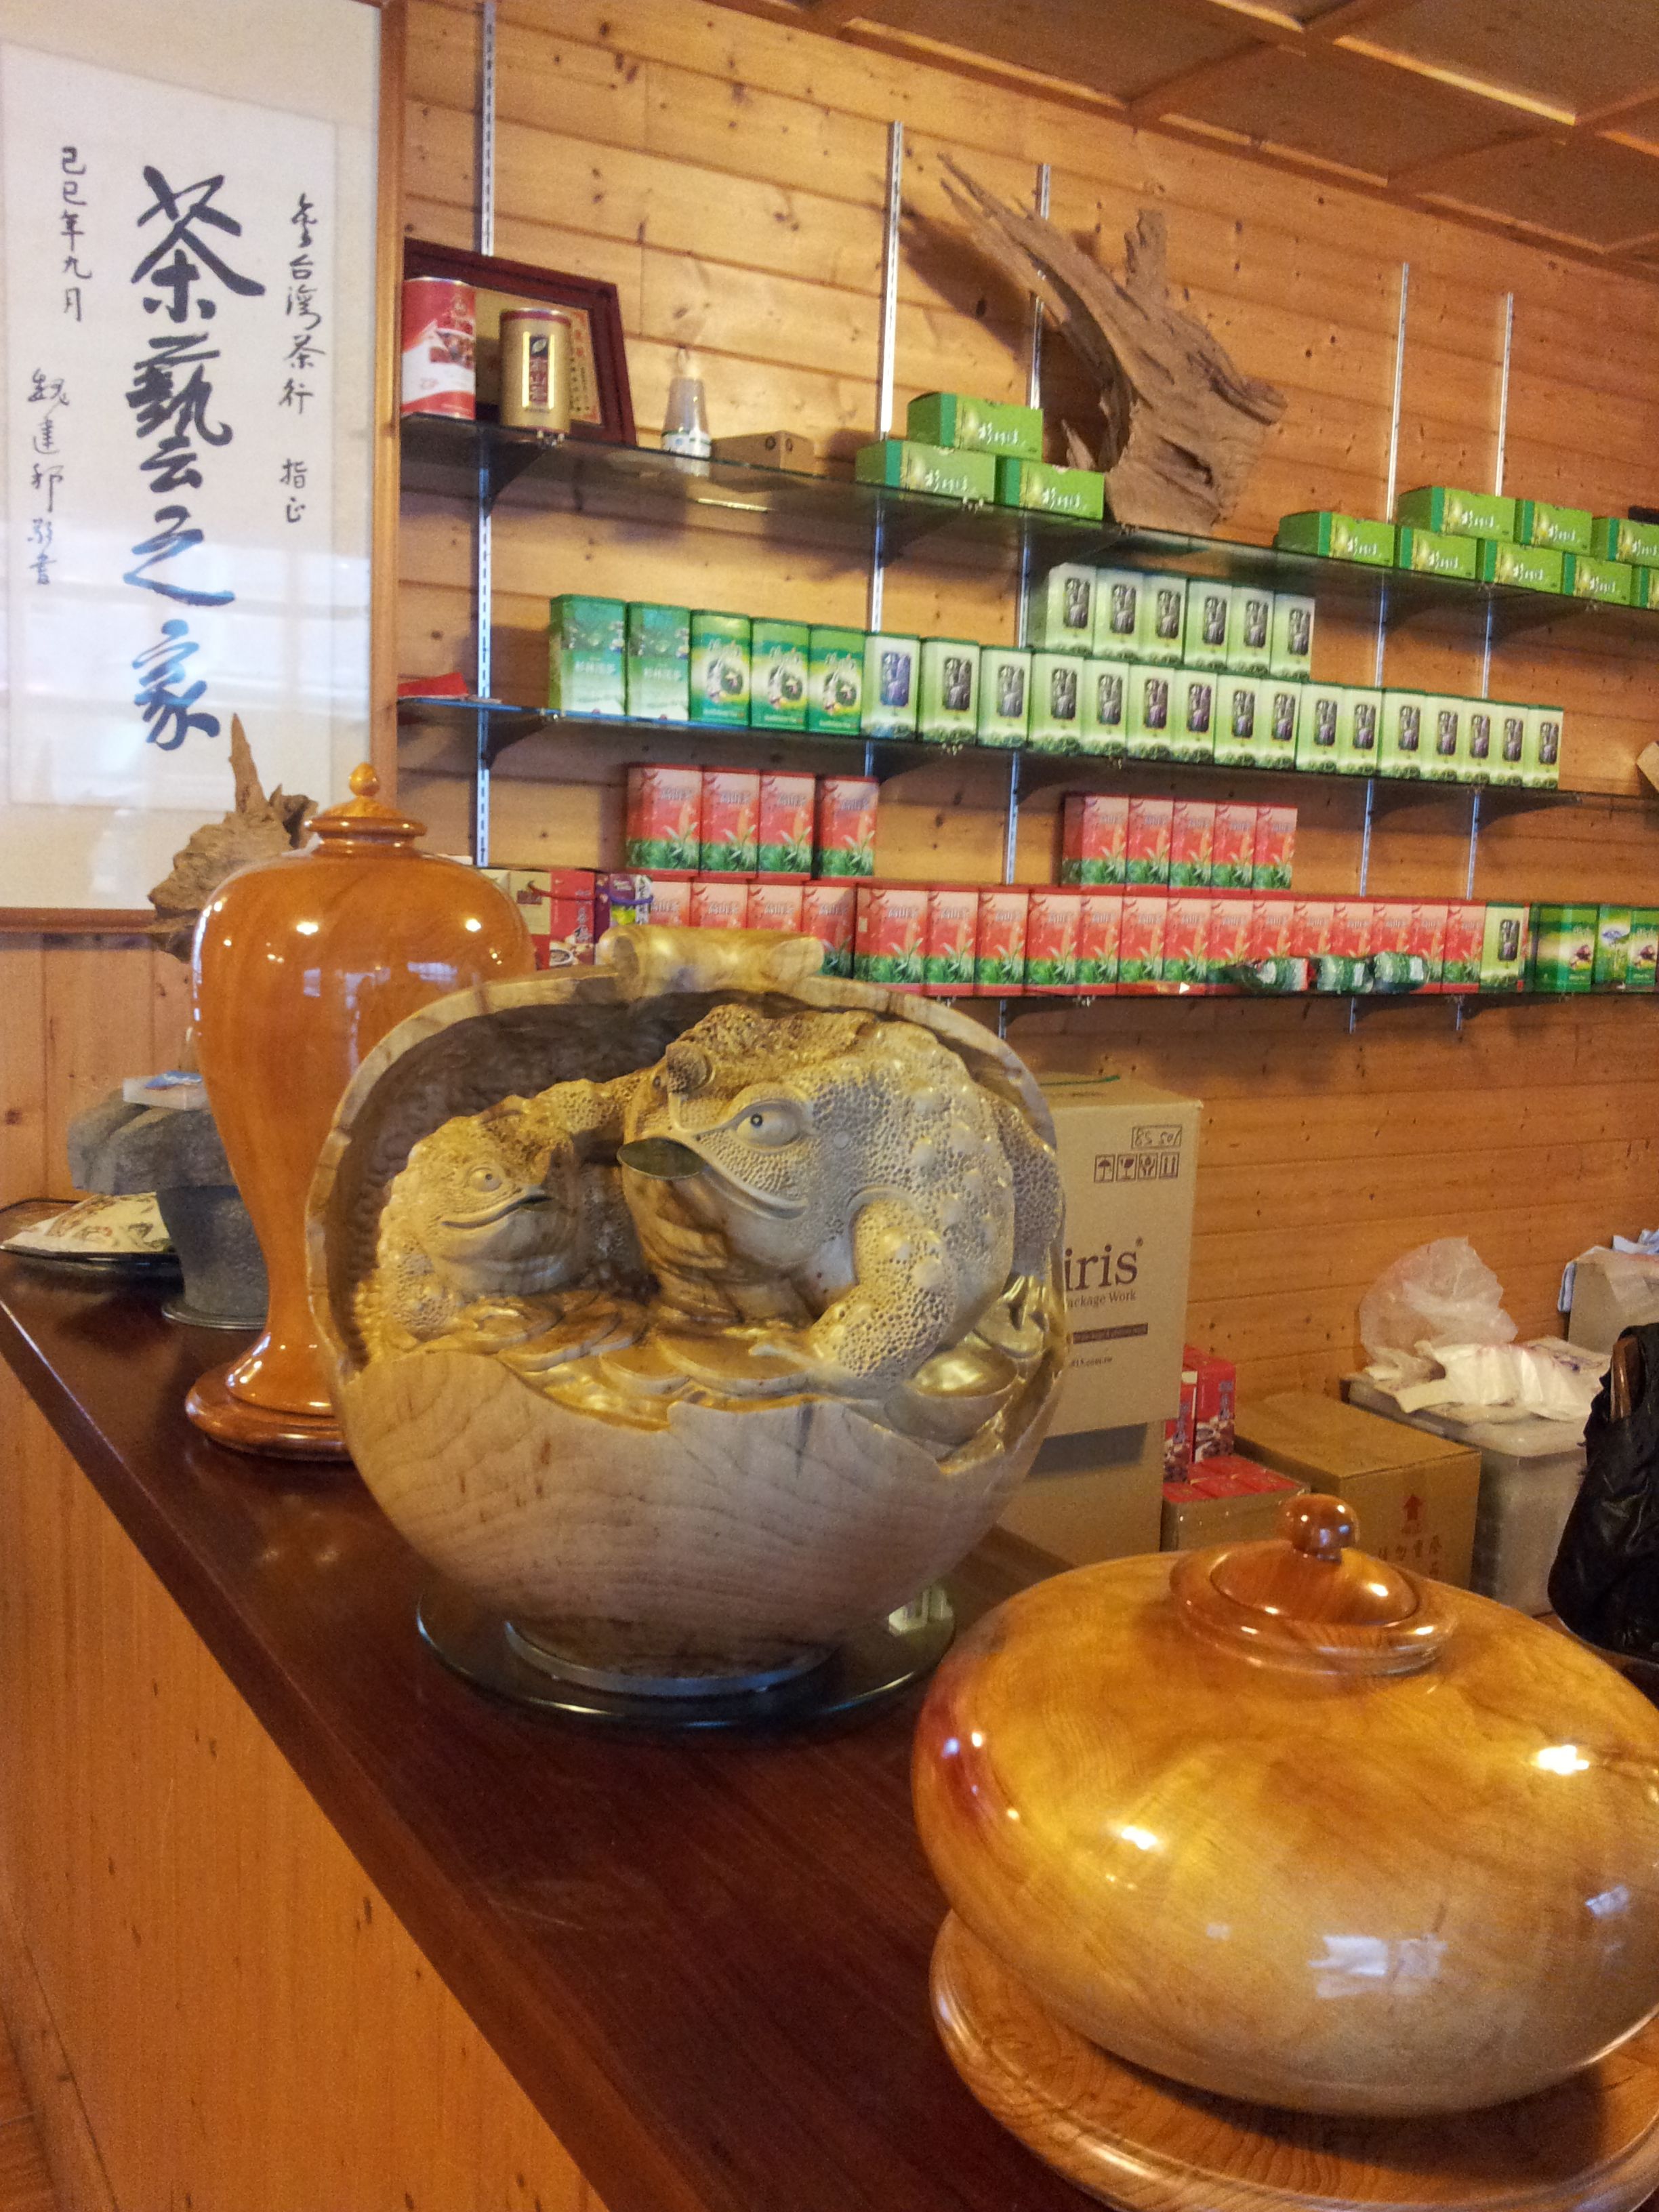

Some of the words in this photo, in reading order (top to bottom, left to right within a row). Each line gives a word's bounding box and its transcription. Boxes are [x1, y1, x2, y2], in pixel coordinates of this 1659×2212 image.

[123, 165, 265, 752] 茶藝之家
[1108, 1288, 1137, 1303] Work
